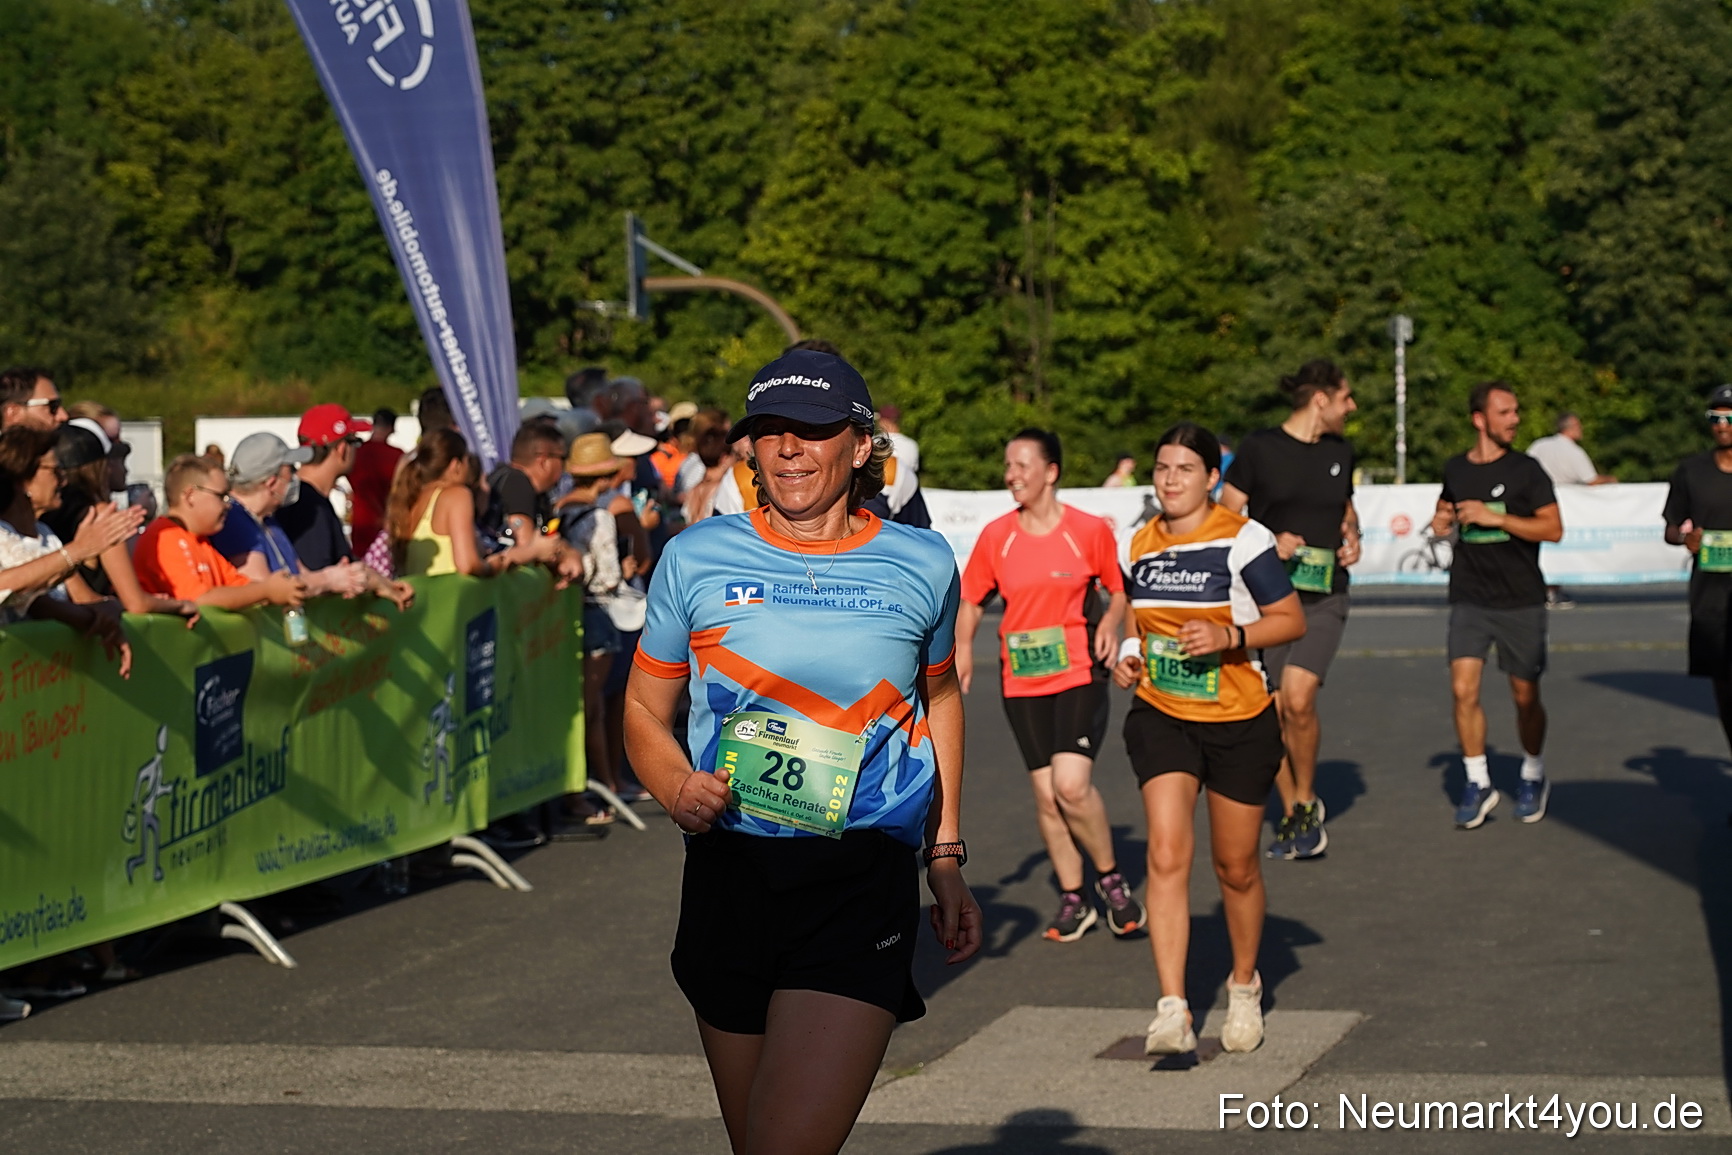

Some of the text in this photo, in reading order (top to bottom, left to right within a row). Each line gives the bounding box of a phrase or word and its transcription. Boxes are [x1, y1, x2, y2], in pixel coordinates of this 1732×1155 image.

[747, 375, 831, 401] TaylorMade
[1146, 568, 1212, 584] Fischer
[772, 583, 868, 596] Raiffeisenbank
[772, 595, 837, 608] Neumarkt
[758, 730, 800, 746] Firmenlauf
[772, 741, 798, 751] neumarkt
[758, 750, 807, 792] 28
[171, 725, 292, 849] firmenlauf
[731, 777, 780, 803] Zaschka
[782, 792, 827, 815] Renate
[825, 774, 849, 823] 2022
